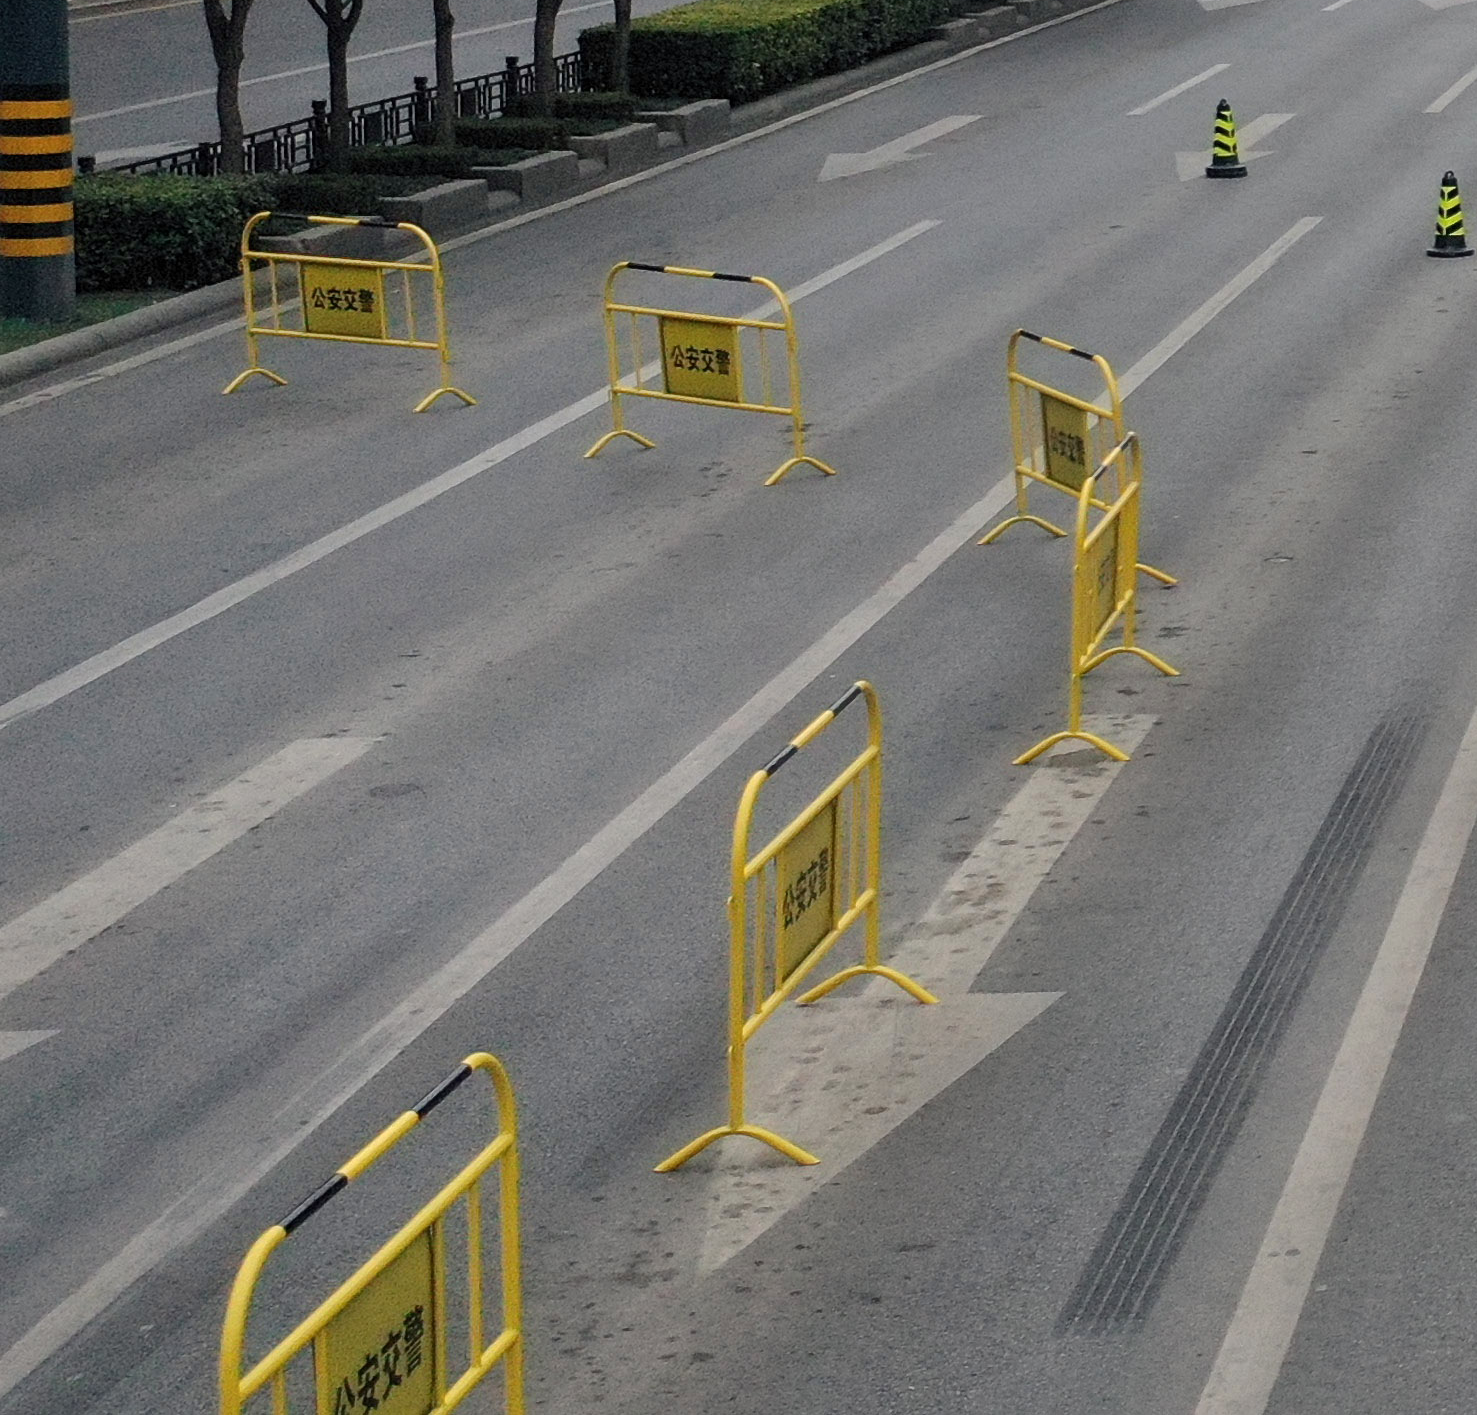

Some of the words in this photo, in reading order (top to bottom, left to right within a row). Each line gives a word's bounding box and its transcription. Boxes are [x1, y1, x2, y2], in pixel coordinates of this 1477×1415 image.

[311, 286, 375, 313] 公安交警
[670, 344, 731, 376] 公安交警
[782, 846, 829, 930] 公安交警
